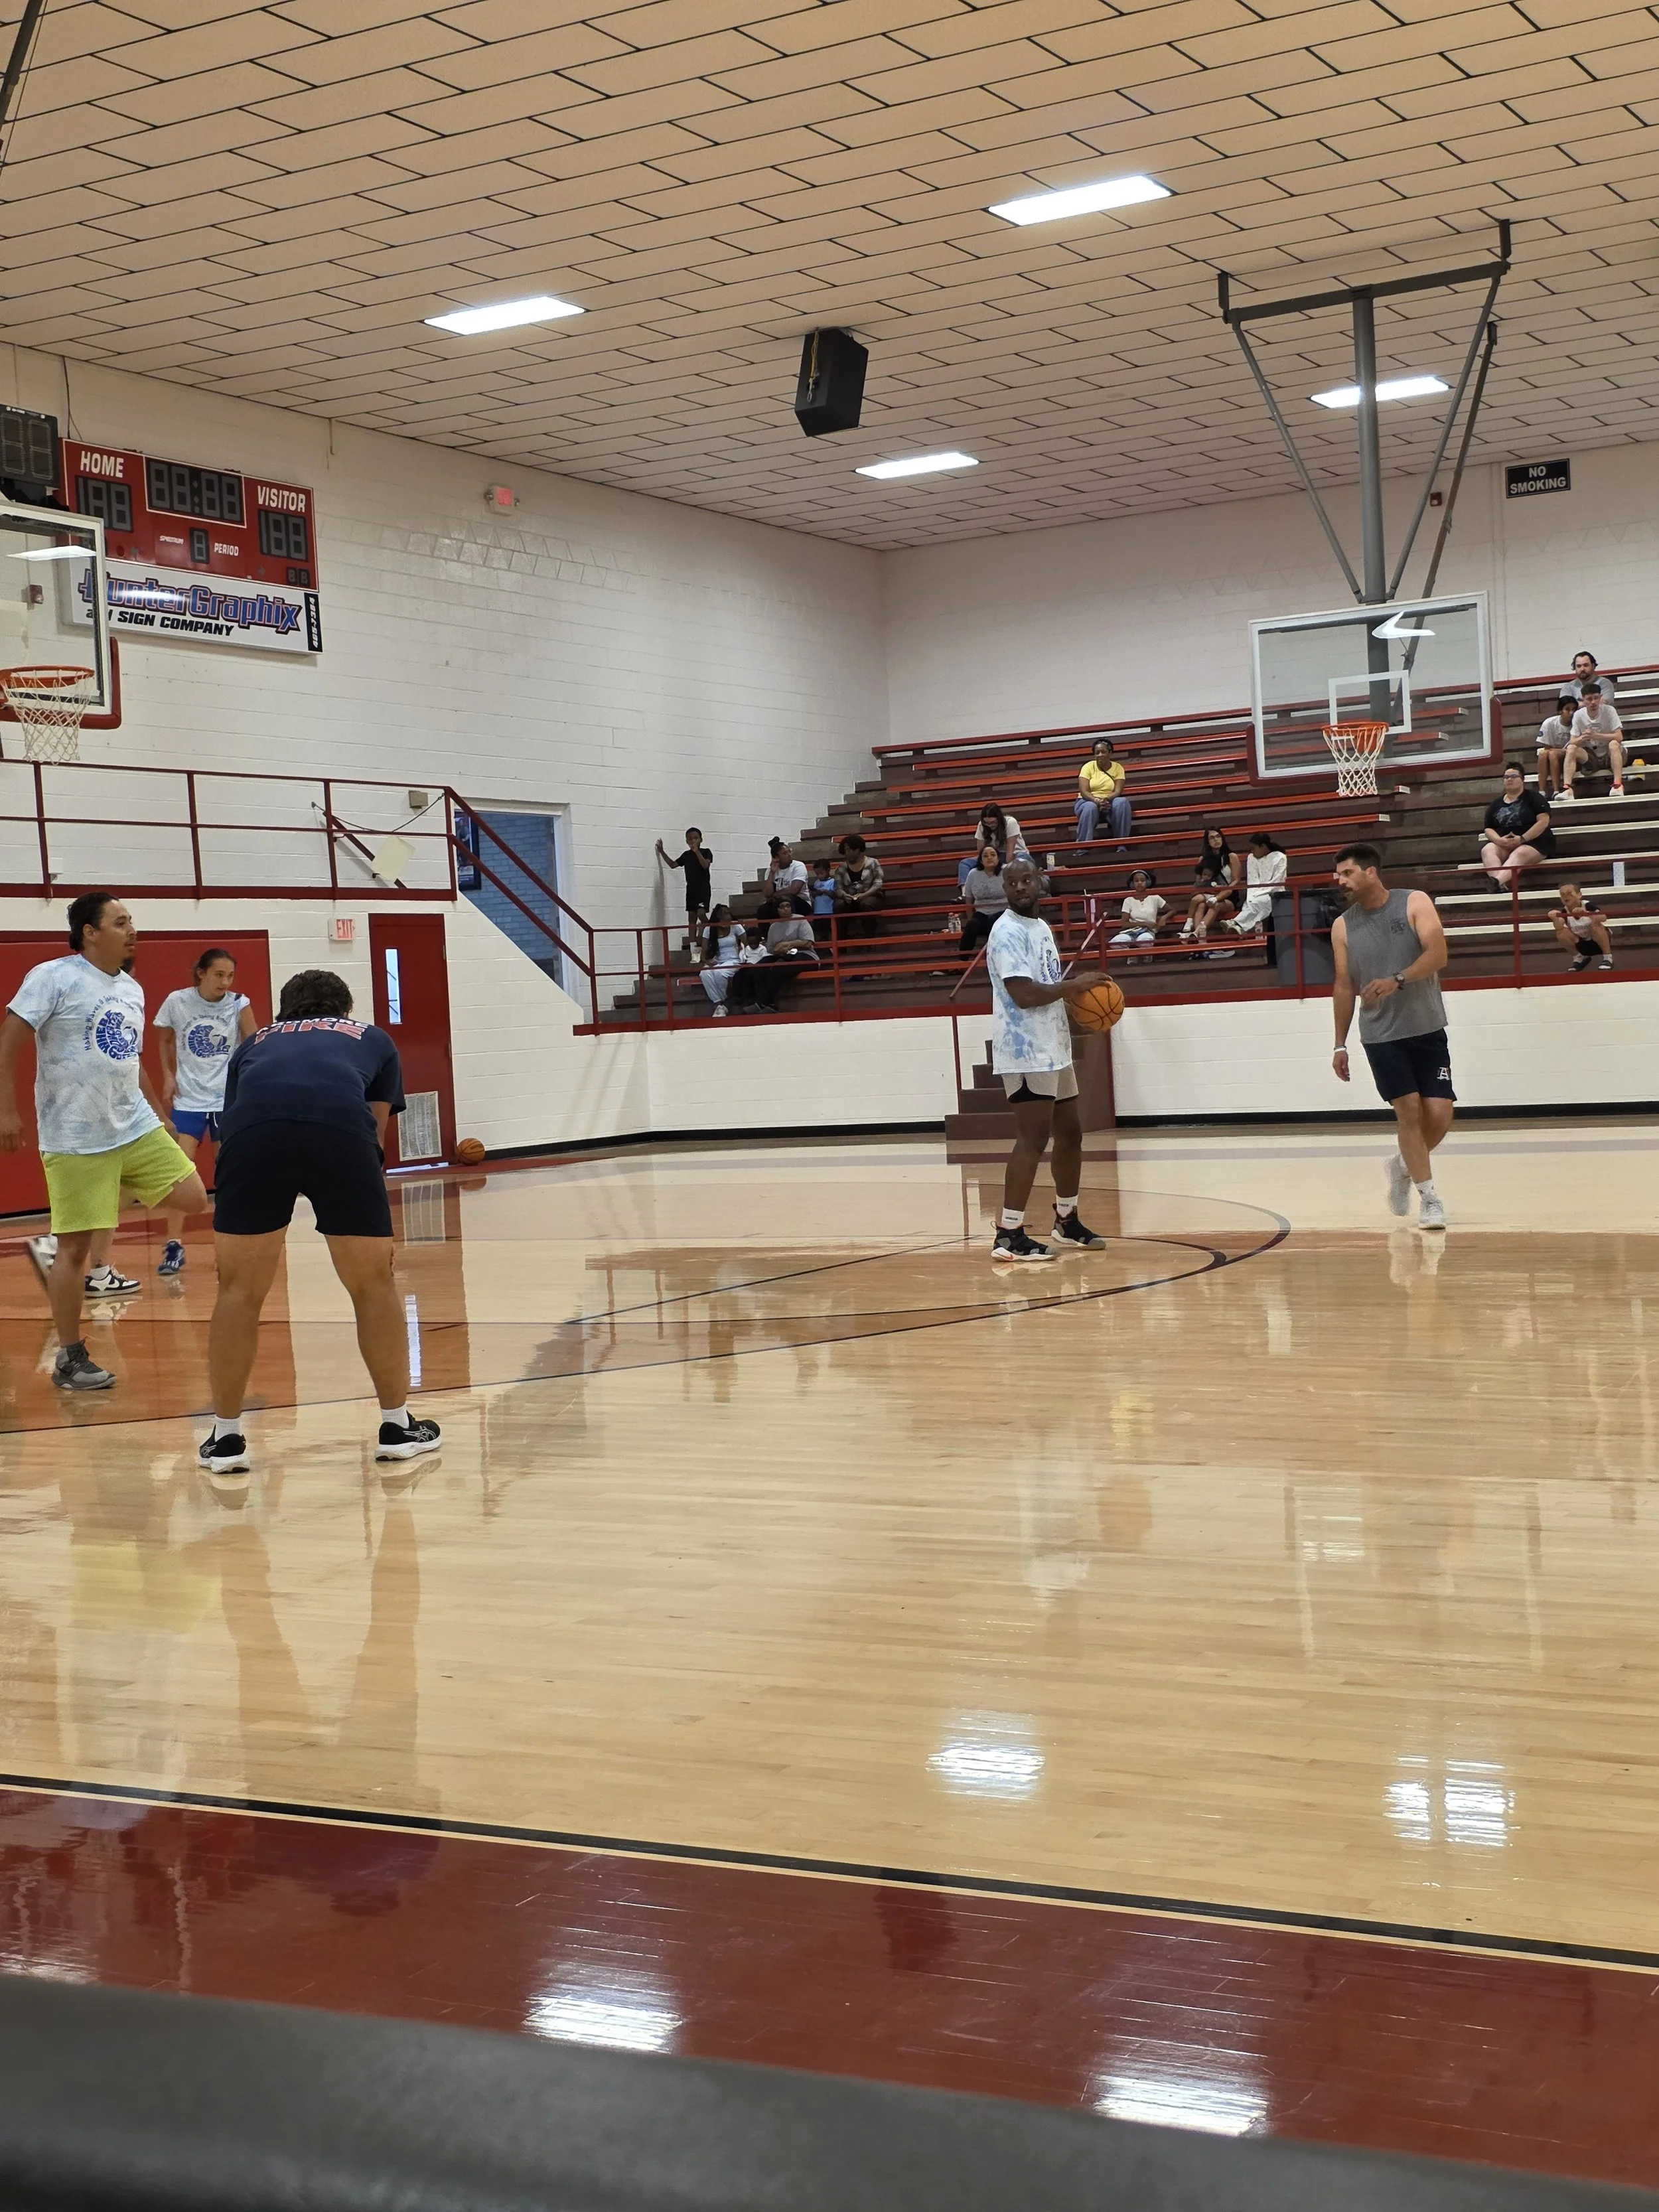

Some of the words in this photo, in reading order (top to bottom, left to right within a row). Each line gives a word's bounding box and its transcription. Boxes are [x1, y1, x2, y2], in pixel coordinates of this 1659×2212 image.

[80, 451, 124, 478] HOME
[1528, 465, 1546, 478] NO
[1510, 477, 1566, 494] SMOKING
[257, 485, 306, 513] VISITOR
[214, 542, 239, 556] PERIOD
[117, 611, 155, 627] SIGN
[160, 616, 234, 636] COMPANY
[336, 919, 353, 938] EXIT
[1437, 1067, 1450, 1080] A
